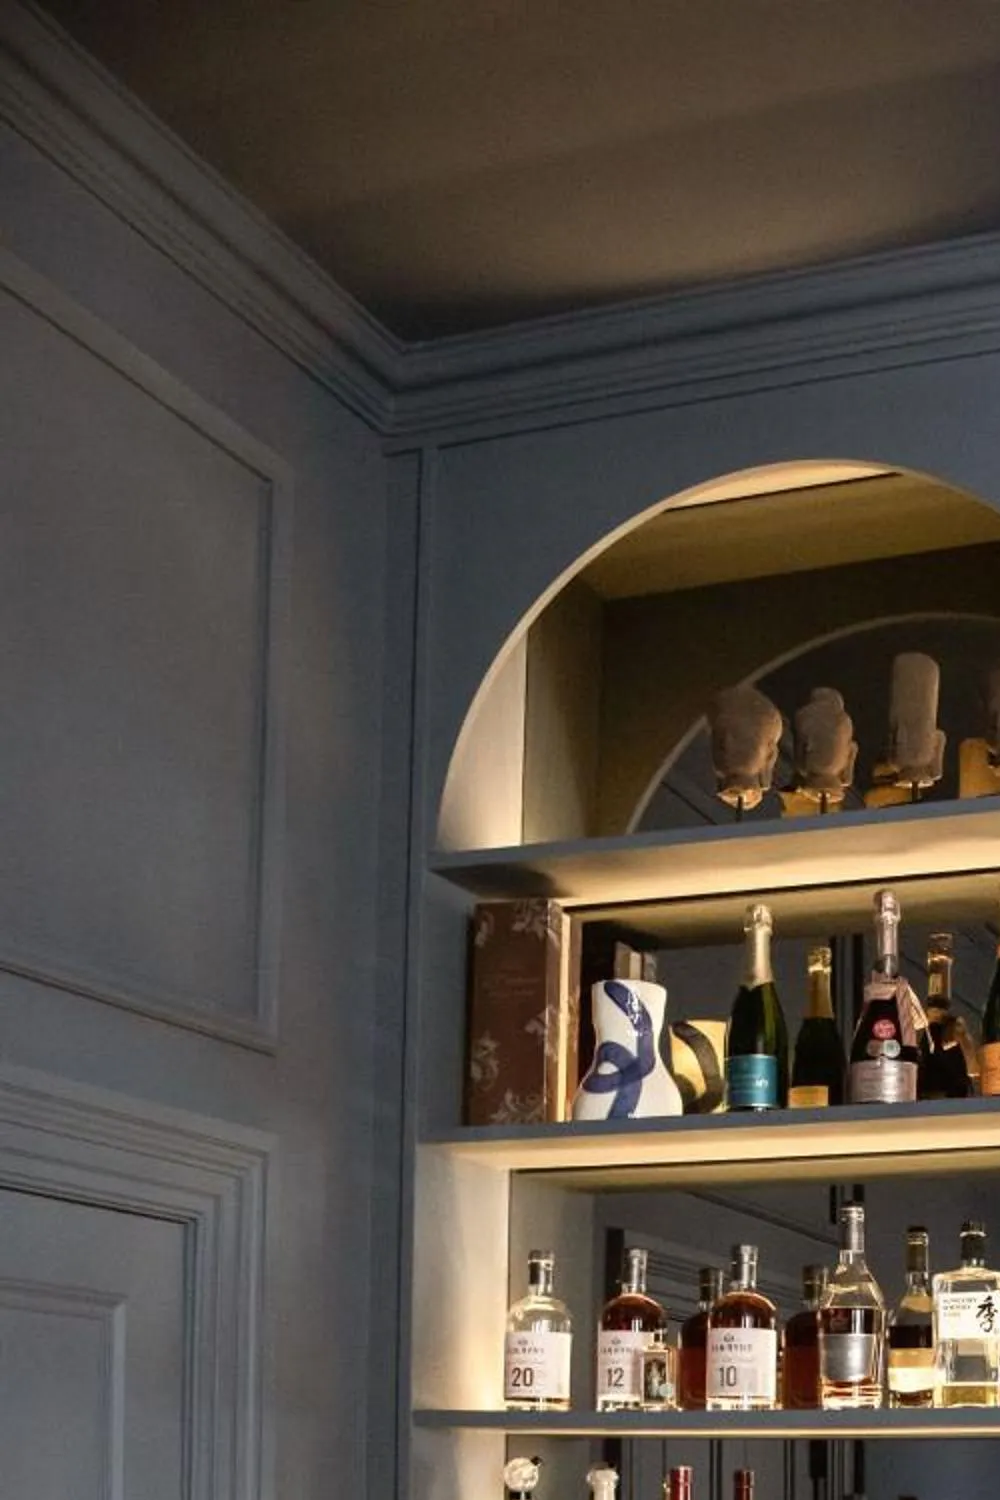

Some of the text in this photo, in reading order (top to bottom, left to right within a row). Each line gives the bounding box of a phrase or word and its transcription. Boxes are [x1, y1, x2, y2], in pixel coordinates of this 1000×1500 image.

[511, 1367, 534, 1387] 20
[607, 1367, 625, 1387] 12
[719, 1365, 737, 1387] 10
